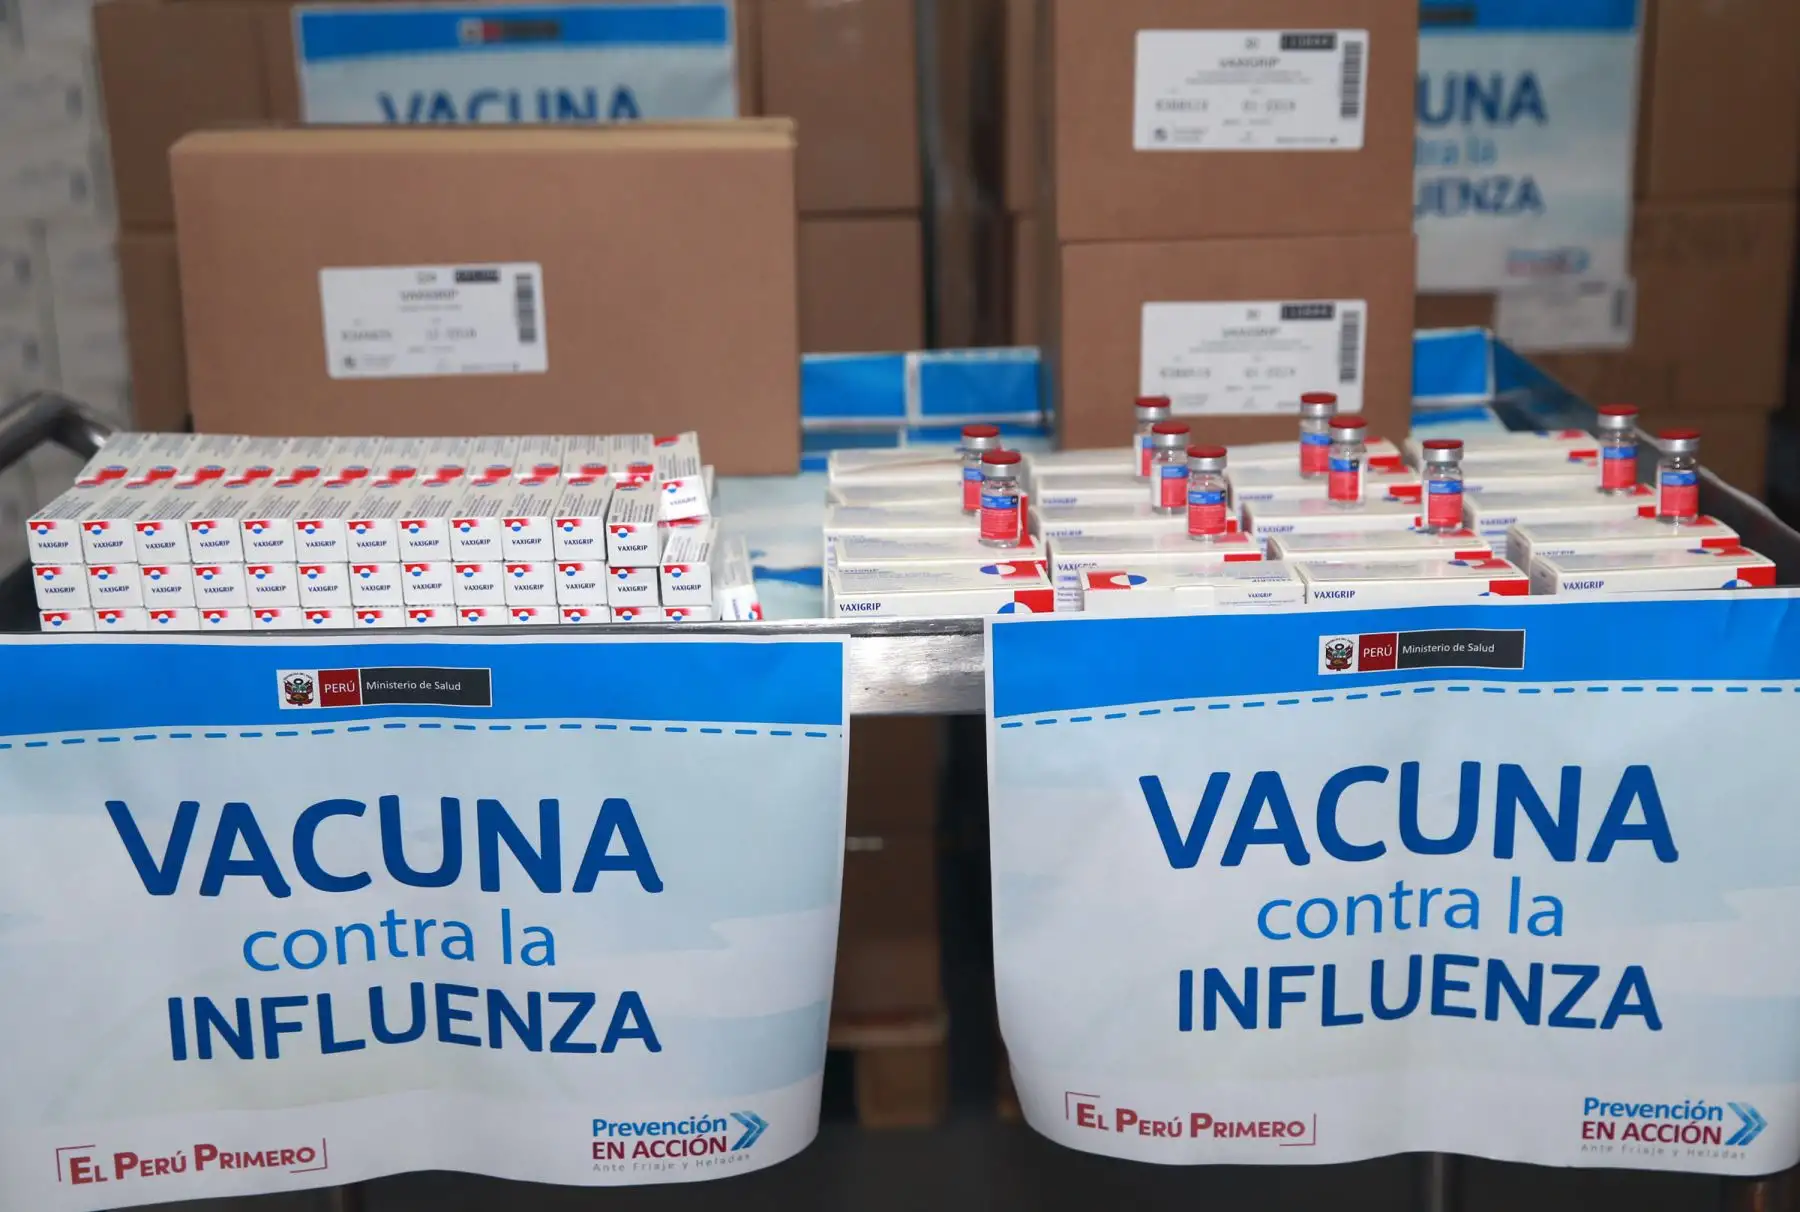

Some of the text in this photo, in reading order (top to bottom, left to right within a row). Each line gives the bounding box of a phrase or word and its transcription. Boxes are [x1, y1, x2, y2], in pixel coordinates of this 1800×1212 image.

[377, 84, 642, 122] VACUNA
[38, 541, 69, 549] VAXIGRIP
[92, 540, 123, 549] VAXIGRIP
[145, 541, 176, 549] VAXIGRIP
[199, 540, 230, 548] VAXIGRIP
[252, 540, 284, 548] VAXIGRIP
[305, 540, 336, 548] VAXIGRIP
[356, 540, 387, 548] VAXIGRIP
[408, 539, 439, 547] VAXIGRIP
[460, 538, 491, 546] VAXIGRIP
[511, 537, 542, 545] VAXIGRIP
[563, 537, 594, 546] VAXIGRIP
[617, 544, 648, 552] VAXIGRIP
[44, 586, 76, 594] VAXIGRIP
[98, 585, 130, 594] VAXIGRIP
[151, 585, 182, 594] VAXIGRIP
[203, 585, 235, 594] VAXIGRIP
[255, 584, 287, 593] VAXIGRIP
[307, 584, 339, 592] VAXIGRIP
[360, 584, 391, 592] VAXIGRIP
[412, 582, 443, 591] VAXIGRIP
[463, 583, 494, 591] VAXIGRIP
[513, 583, 545, 591] VAXIGRIP
[565, 582, 596, 590] VAXIGRIP
[617, 585, 648, 593] VAXIGRIP
[671, 584, 702, 592] VAXIGRIP
[1562, 581, 1605, 590] VAXIGRIP
[1313, 590, 1356, 600] VAXIGRIP
[839, 602, 881, 612] VAXIGRIP
[1363, 646, 1392, 658] PERÚ
[1402, 643, 1495, 654] Ministerio de Salud
[324, 680, 355, 693] PERÚ
[366, 681, 461, 691] Ministerio de Salud
[1139, 761, 1678, 868] VACUNA
[106, 793, 663, 898] VACUNA
[1258, 875, 1564, 941] contra la
[243, 908, 556, 972] contra la
[1180, 954, 1662, 1031] INFLUENZA
[169, 982, 662, 1060] INFLUENZA
[1583, 1096, 1723, 1122] Prevención
[592, 1114, 727, 1137] Prevención
[1581, 1120, 1722, 1145] EN ACCIÓN
[592, 1134, 727, 1160] EN ACCIÓN
[1581, 1144, 1614, 1153] Ante
[592, 1163, 625, 1172] Ante
